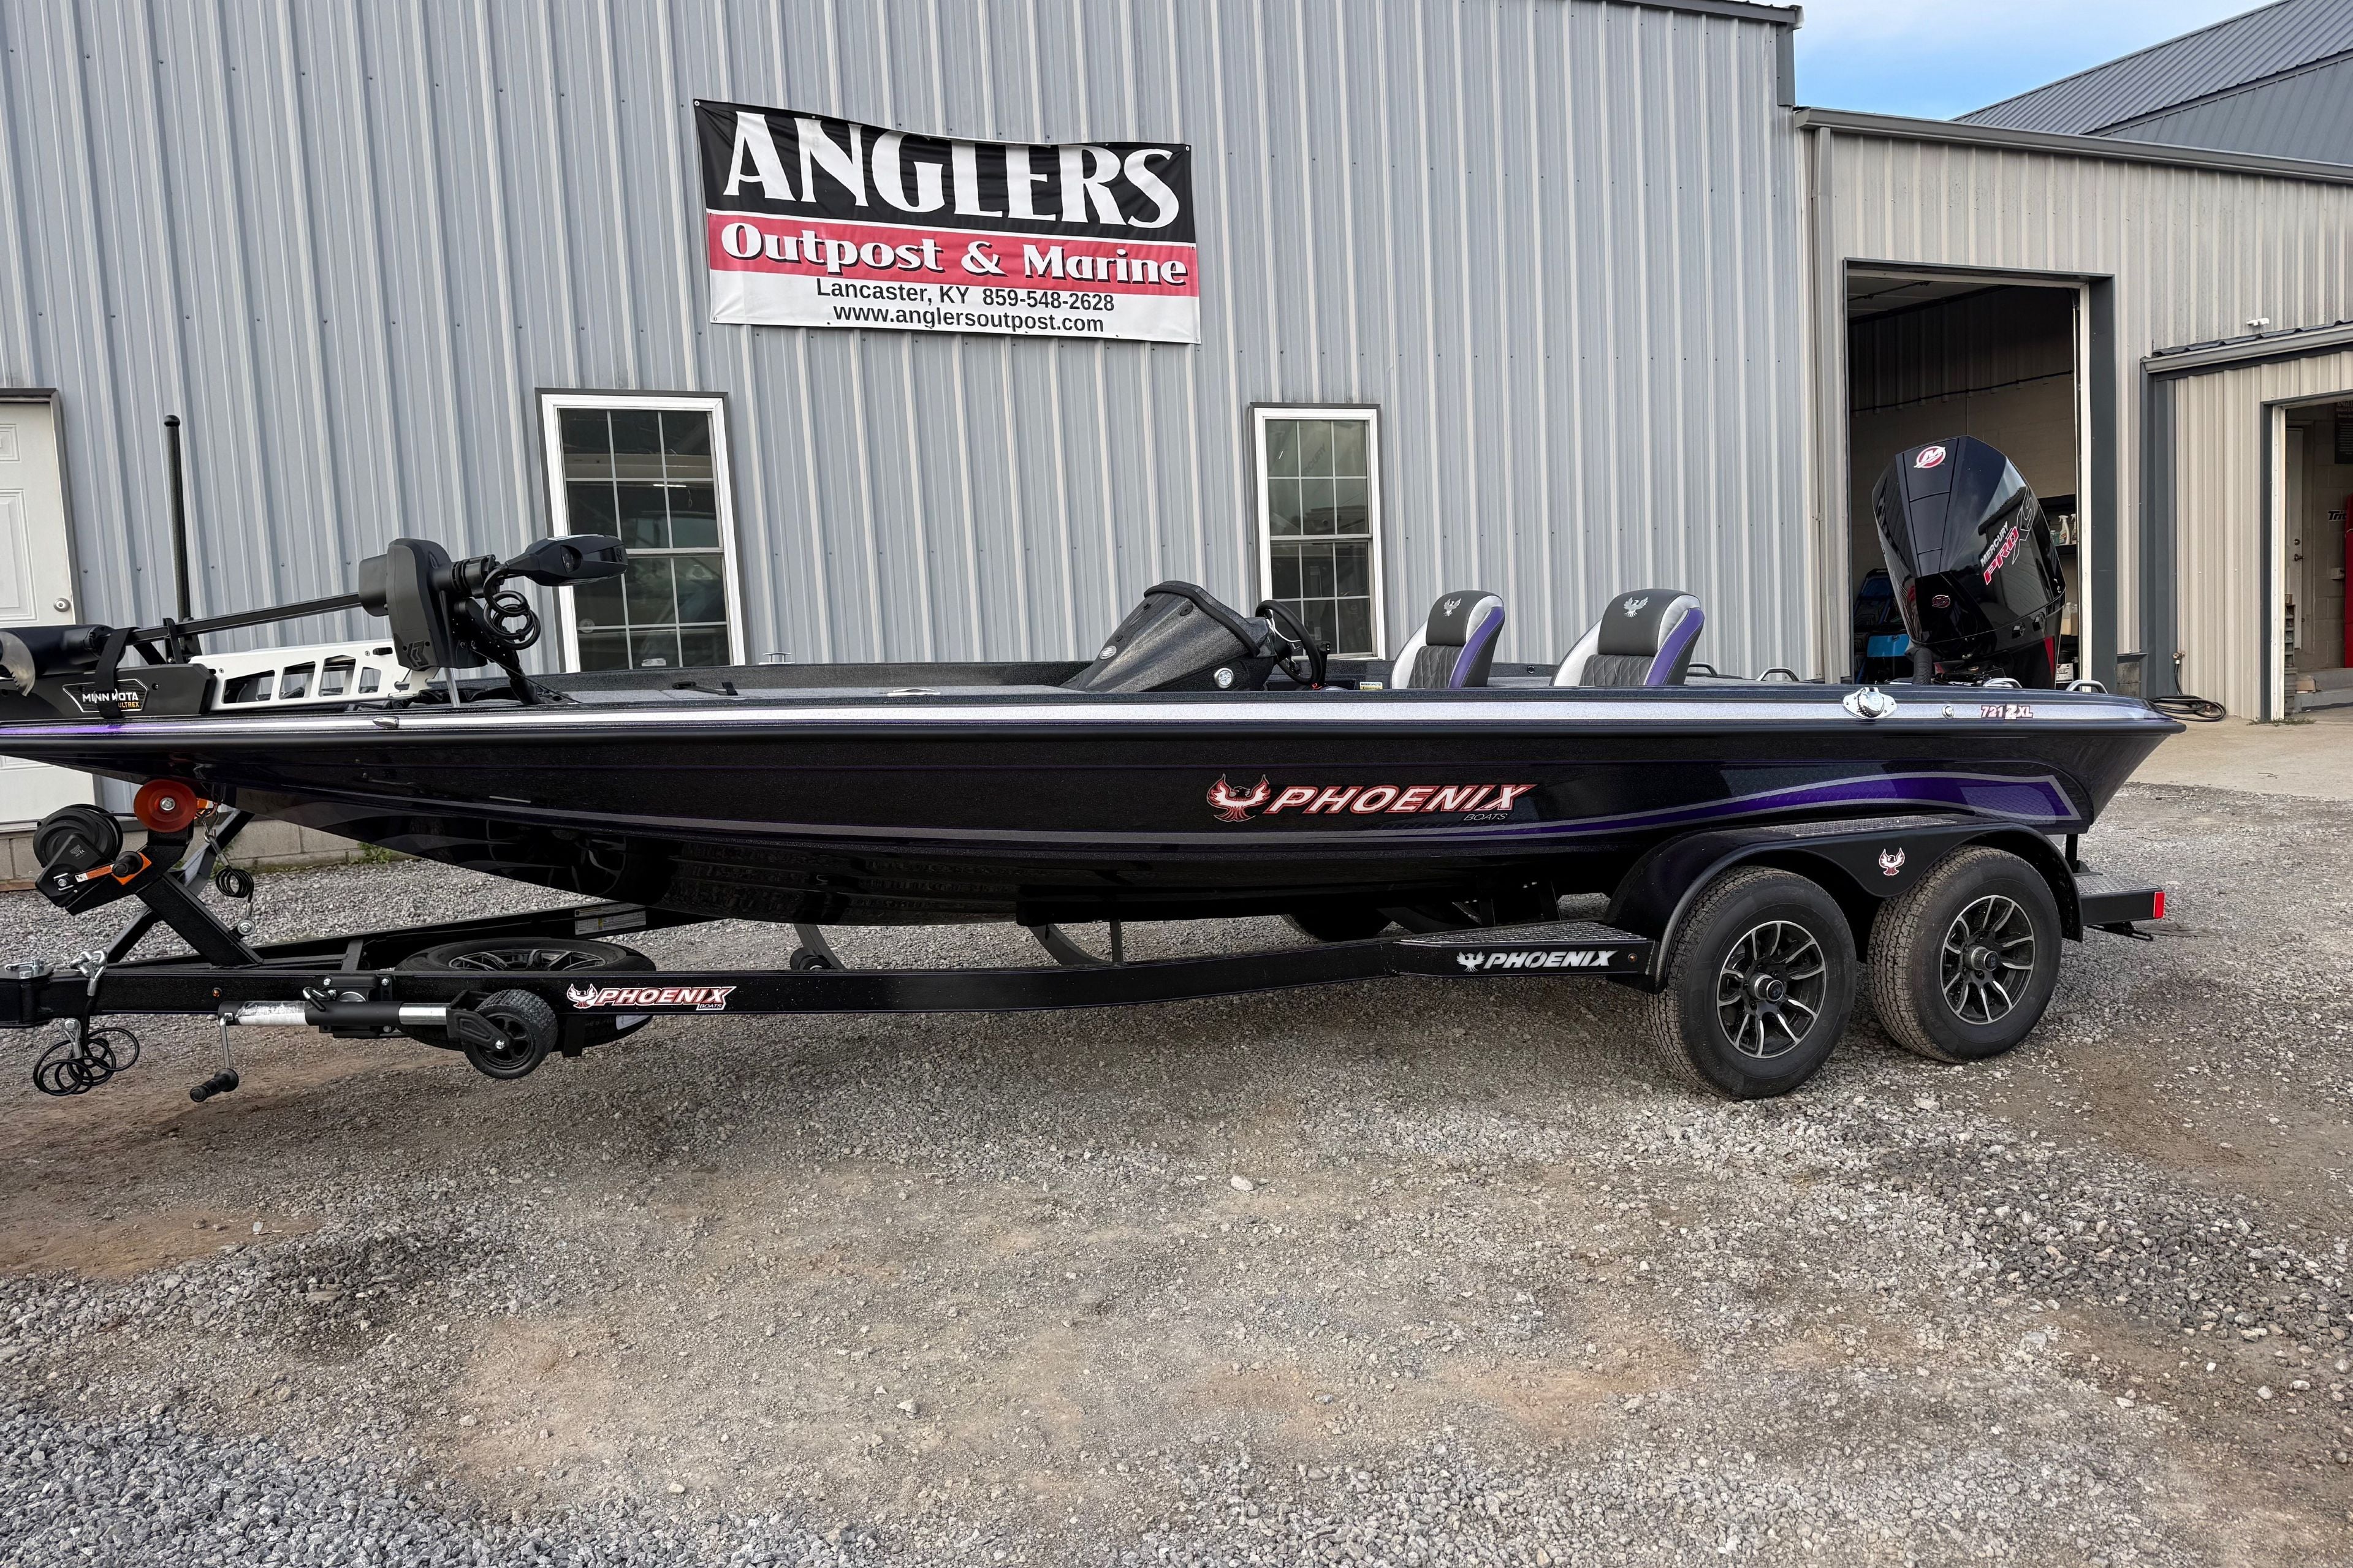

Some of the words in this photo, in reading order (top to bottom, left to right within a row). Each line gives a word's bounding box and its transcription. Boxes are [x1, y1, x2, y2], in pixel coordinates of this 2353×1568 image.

[723, 110, 1179, 229] ANGLERS
[721, 222, 945, 275] Outpost
[961, 240, 1009, 278] &
[1024, 243, 1188, 286] Marine
[816, 278, 932, 306] Lancaster,
[940, 286, 969, 305] KY
[982, 290, 1114, 311] 859-548-2628
[834, 304, 1104, 333] www.anglersoutpost.com
[1980, 521, 2009, 567] MERCURY
[1983, 526, 2019, 586] PRO
[82, 693, 110, 703] MINN
[112, 691, 139, 702] KOTA
[1263, 784, 1538, 814] PHOENIX
[1483, 950, 1619, 969] PHOENIX
[593, 987, 736, 1005] PHOENIX
